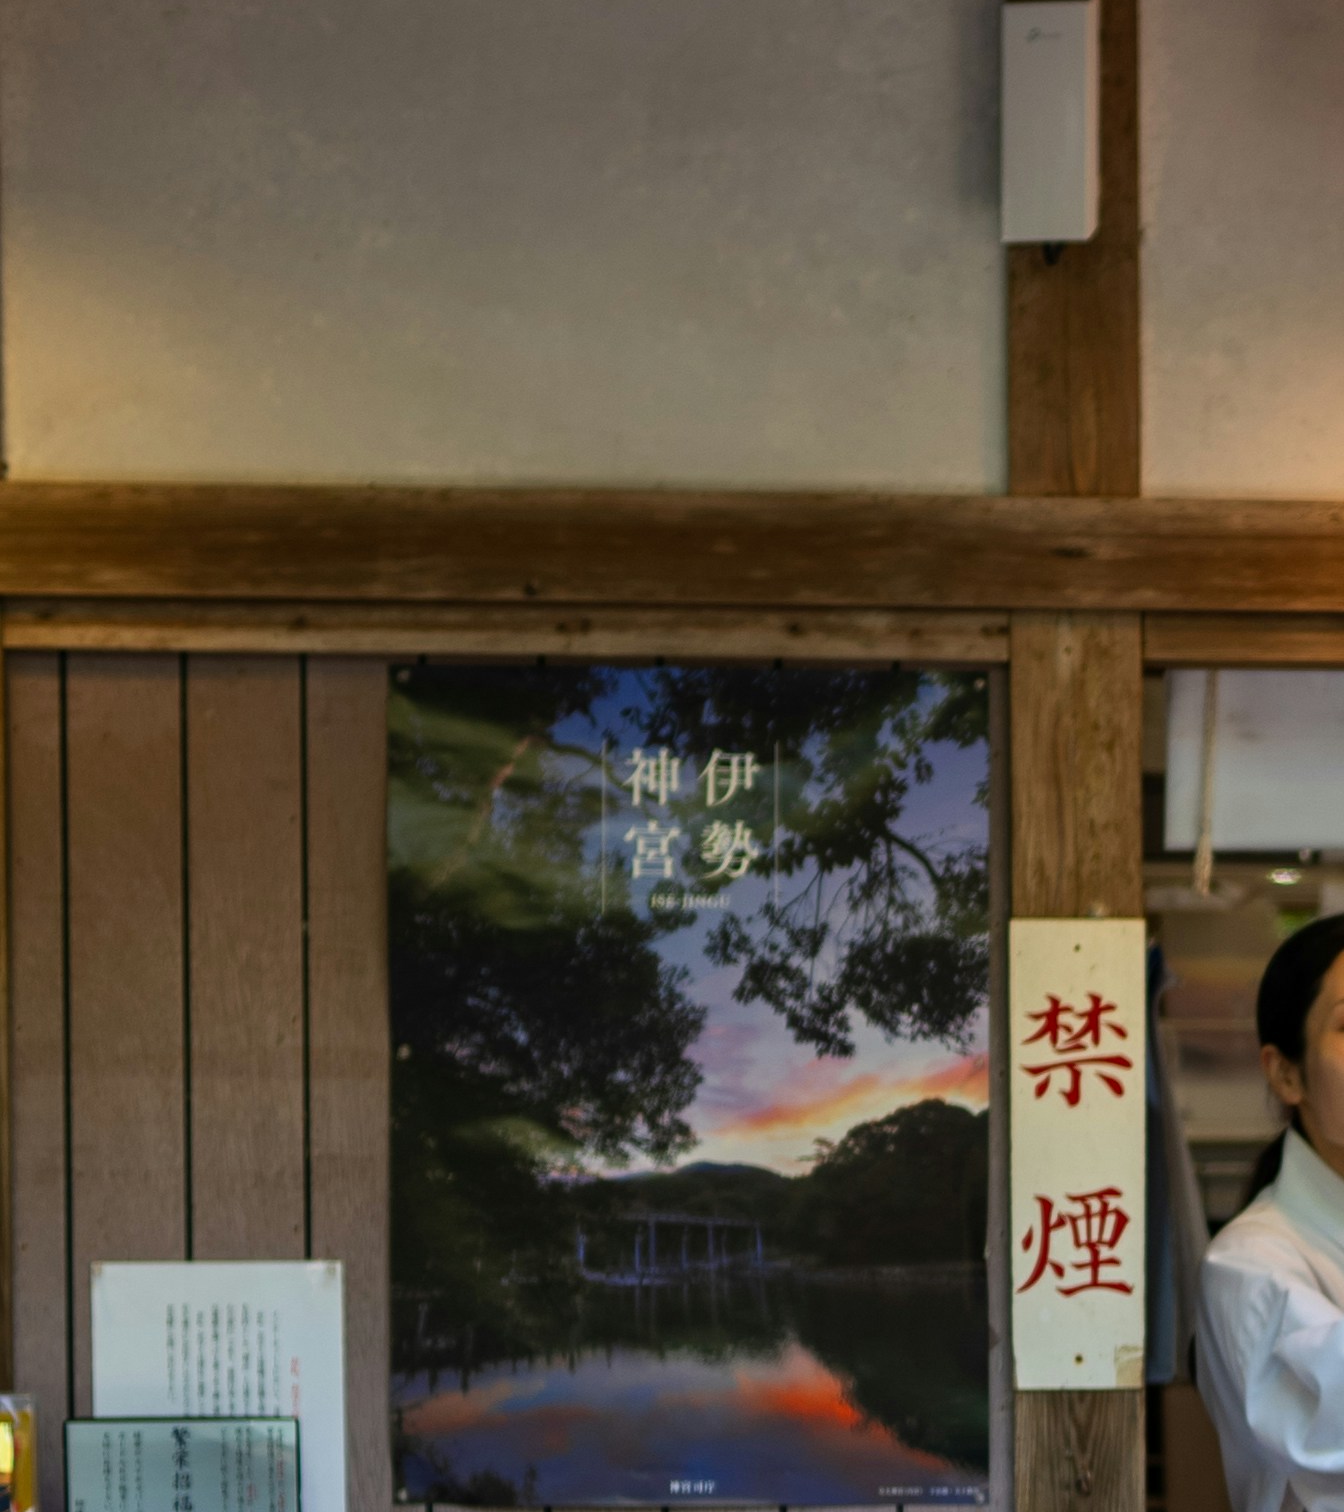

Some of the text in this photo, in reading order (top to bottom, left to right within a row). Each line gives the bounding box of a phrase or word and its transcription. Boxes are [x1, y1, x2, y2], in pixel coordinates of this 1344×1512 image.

[621, 747, 682, 879] 神宮
[696, 747, 761, 880] 伊勢
[1017, 992, 1134, 1296] 禁煙
[669, 1480, 717, 1495] 神宮司庁
